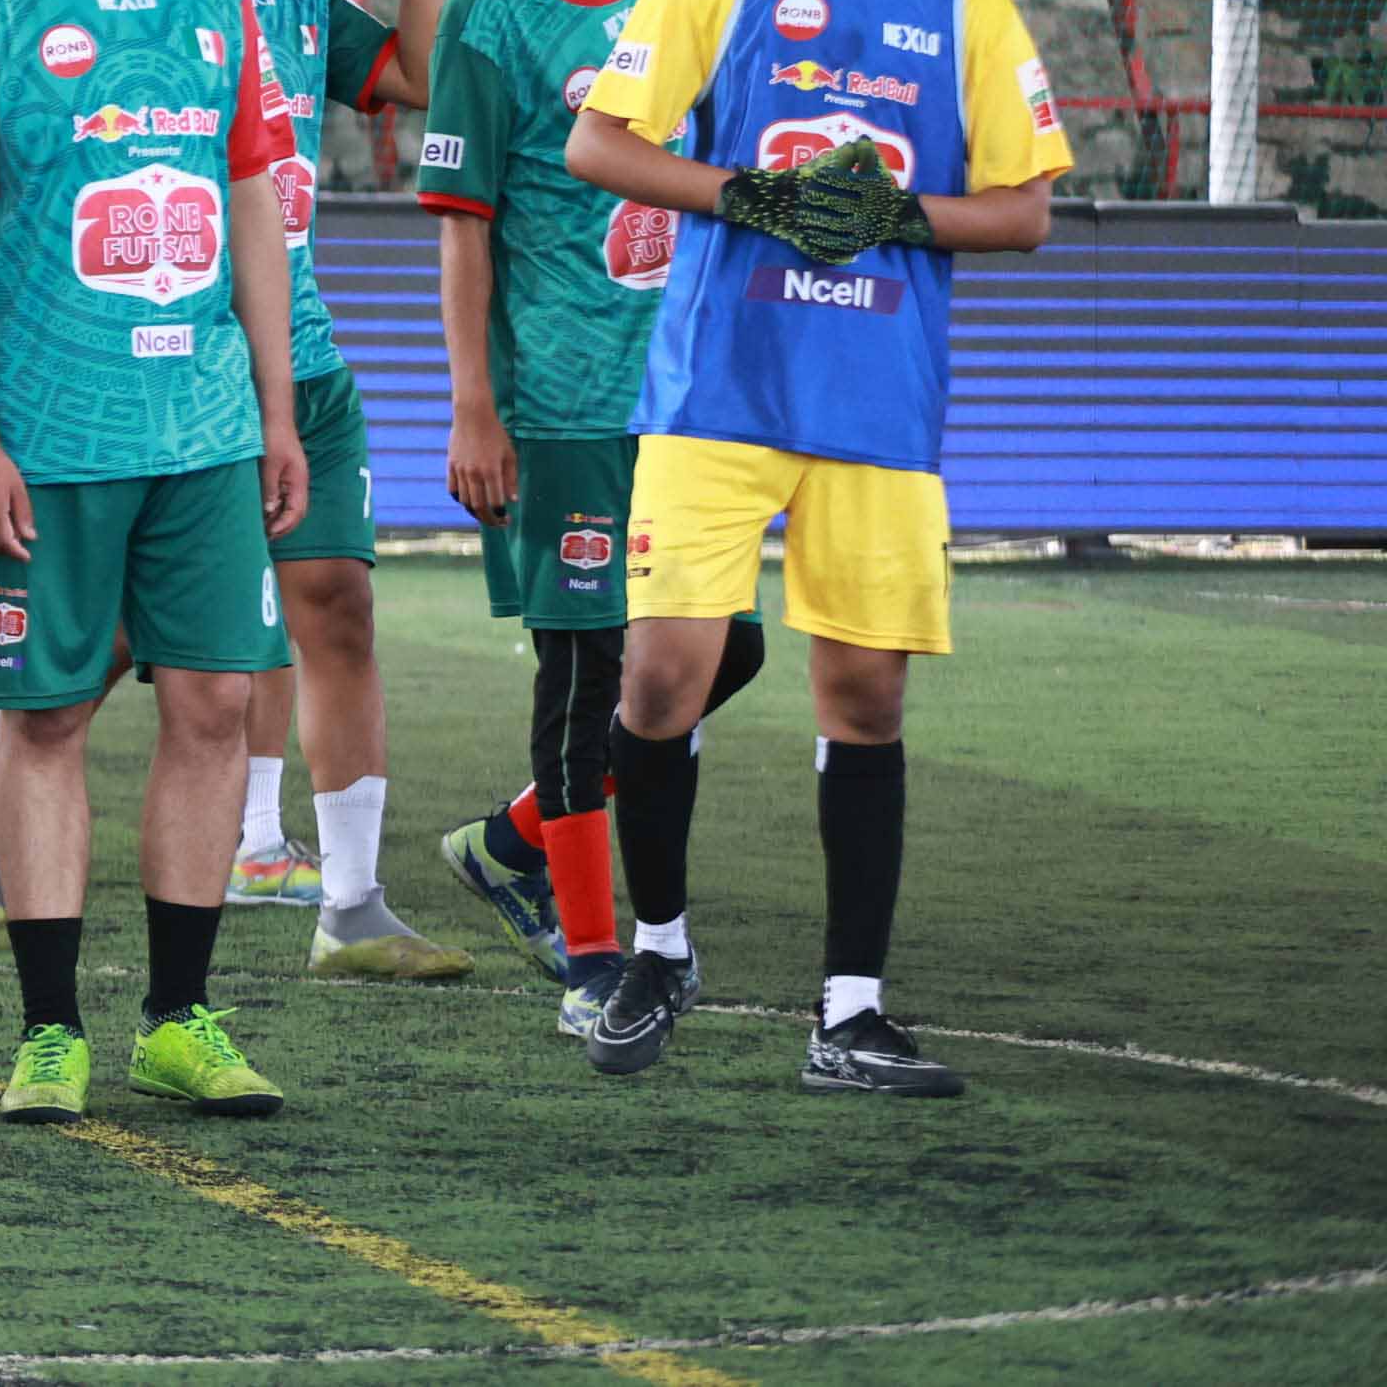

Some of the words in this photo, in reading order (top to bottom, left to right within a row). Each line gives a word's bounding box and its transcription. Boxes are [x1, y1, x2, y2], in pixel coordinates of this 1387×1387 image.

[779, 6, 821, 20] RONB
[45, 41, 88, 56] RONB
[883, 22, 941, 56] NEXLO
[609, 49, 648, 73] ell
[848, 72, 884, 98] Red
[886, 78, 919, 105] Bull
[152, 109, 190, 133] Red
[193, 109, 219, 134] Bull
[128, 146, 181, 157] Presents
[425, 140, 460, 164] ell
[108, 202, 202, 235] RONB
[623, 208, 676, 238] RO
[103, 234, 206, 265] FUTSAL
[628, 237, 676, 266] FUT
[783, 269, 874, 308] Ncell
[136, 329, 189, 353] Ncel
[261, 566, 276, 627] 8
[569, 578, 598, 591] Ncell
